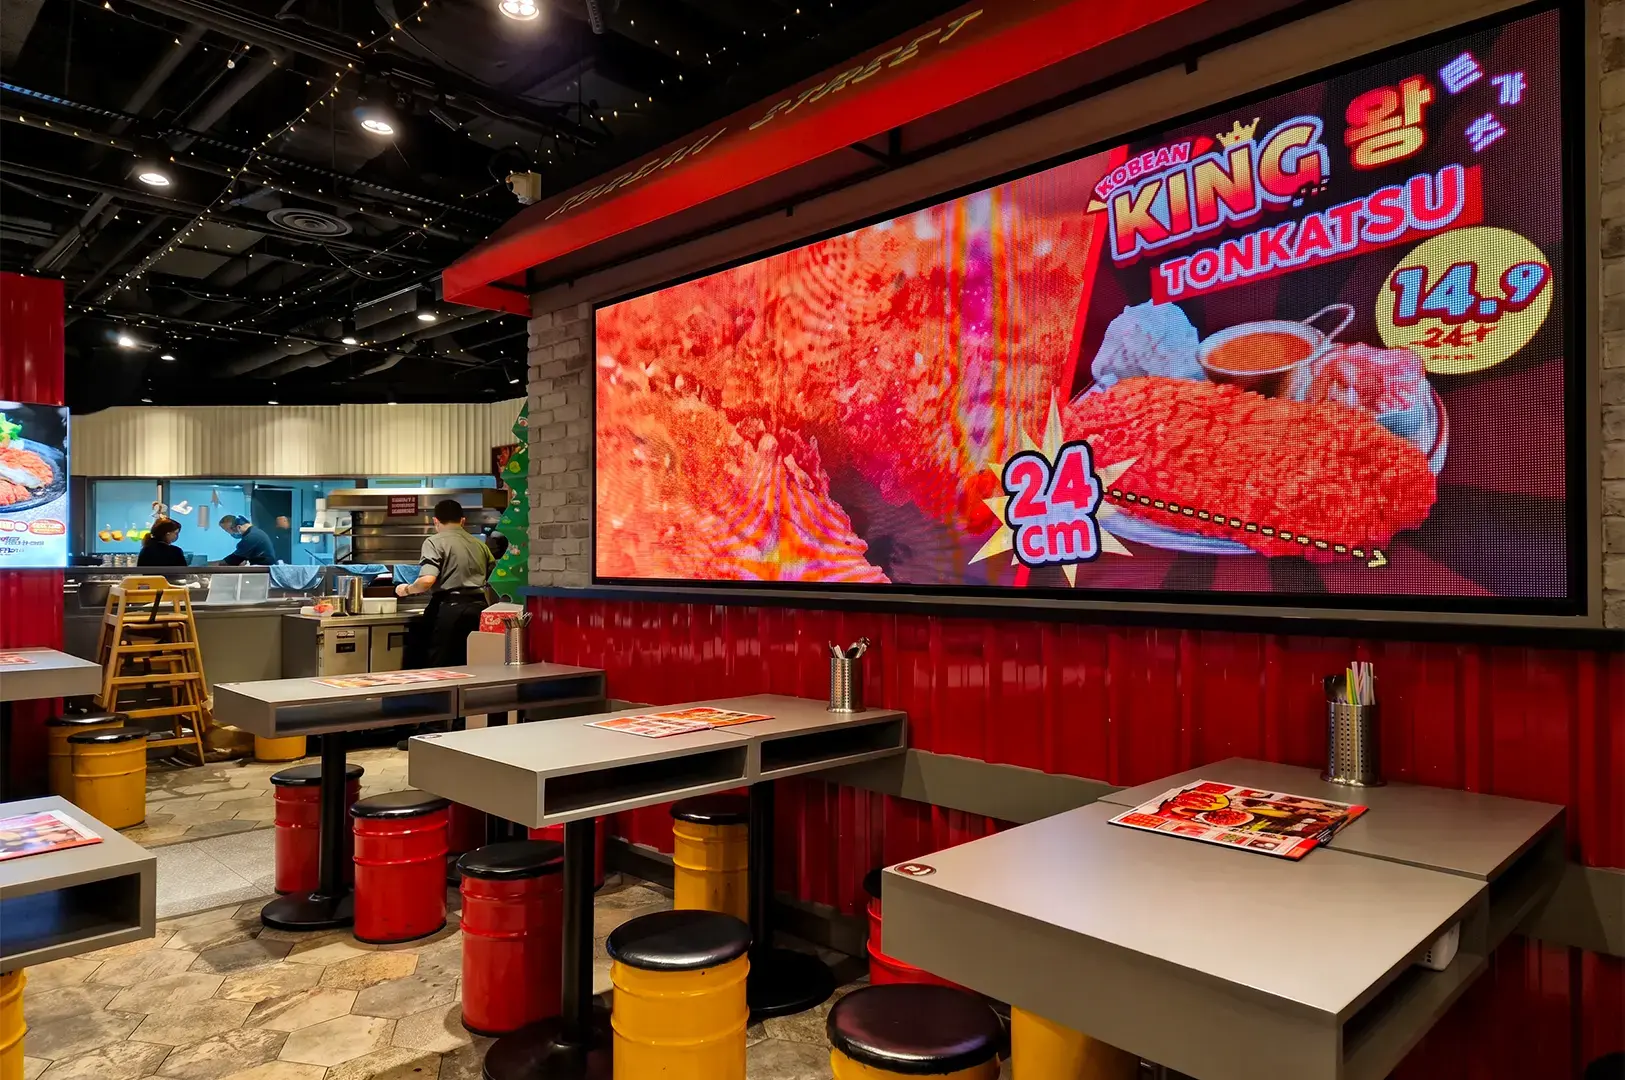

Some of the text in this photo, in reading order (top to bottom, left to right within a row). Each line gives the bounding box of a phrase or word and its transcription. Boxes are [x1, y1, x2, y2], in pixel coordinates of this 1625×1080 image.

[1345, 75, 1434, 170] 왕
[1108, 116, 1330, 261] KING
[1159, 162, 1465, 296] TONKATSU
[1390, 260, 1553, 327] 14.9
[1008, 448, 1094, 520] 24
[1019, 517, 1093, 562] cm
